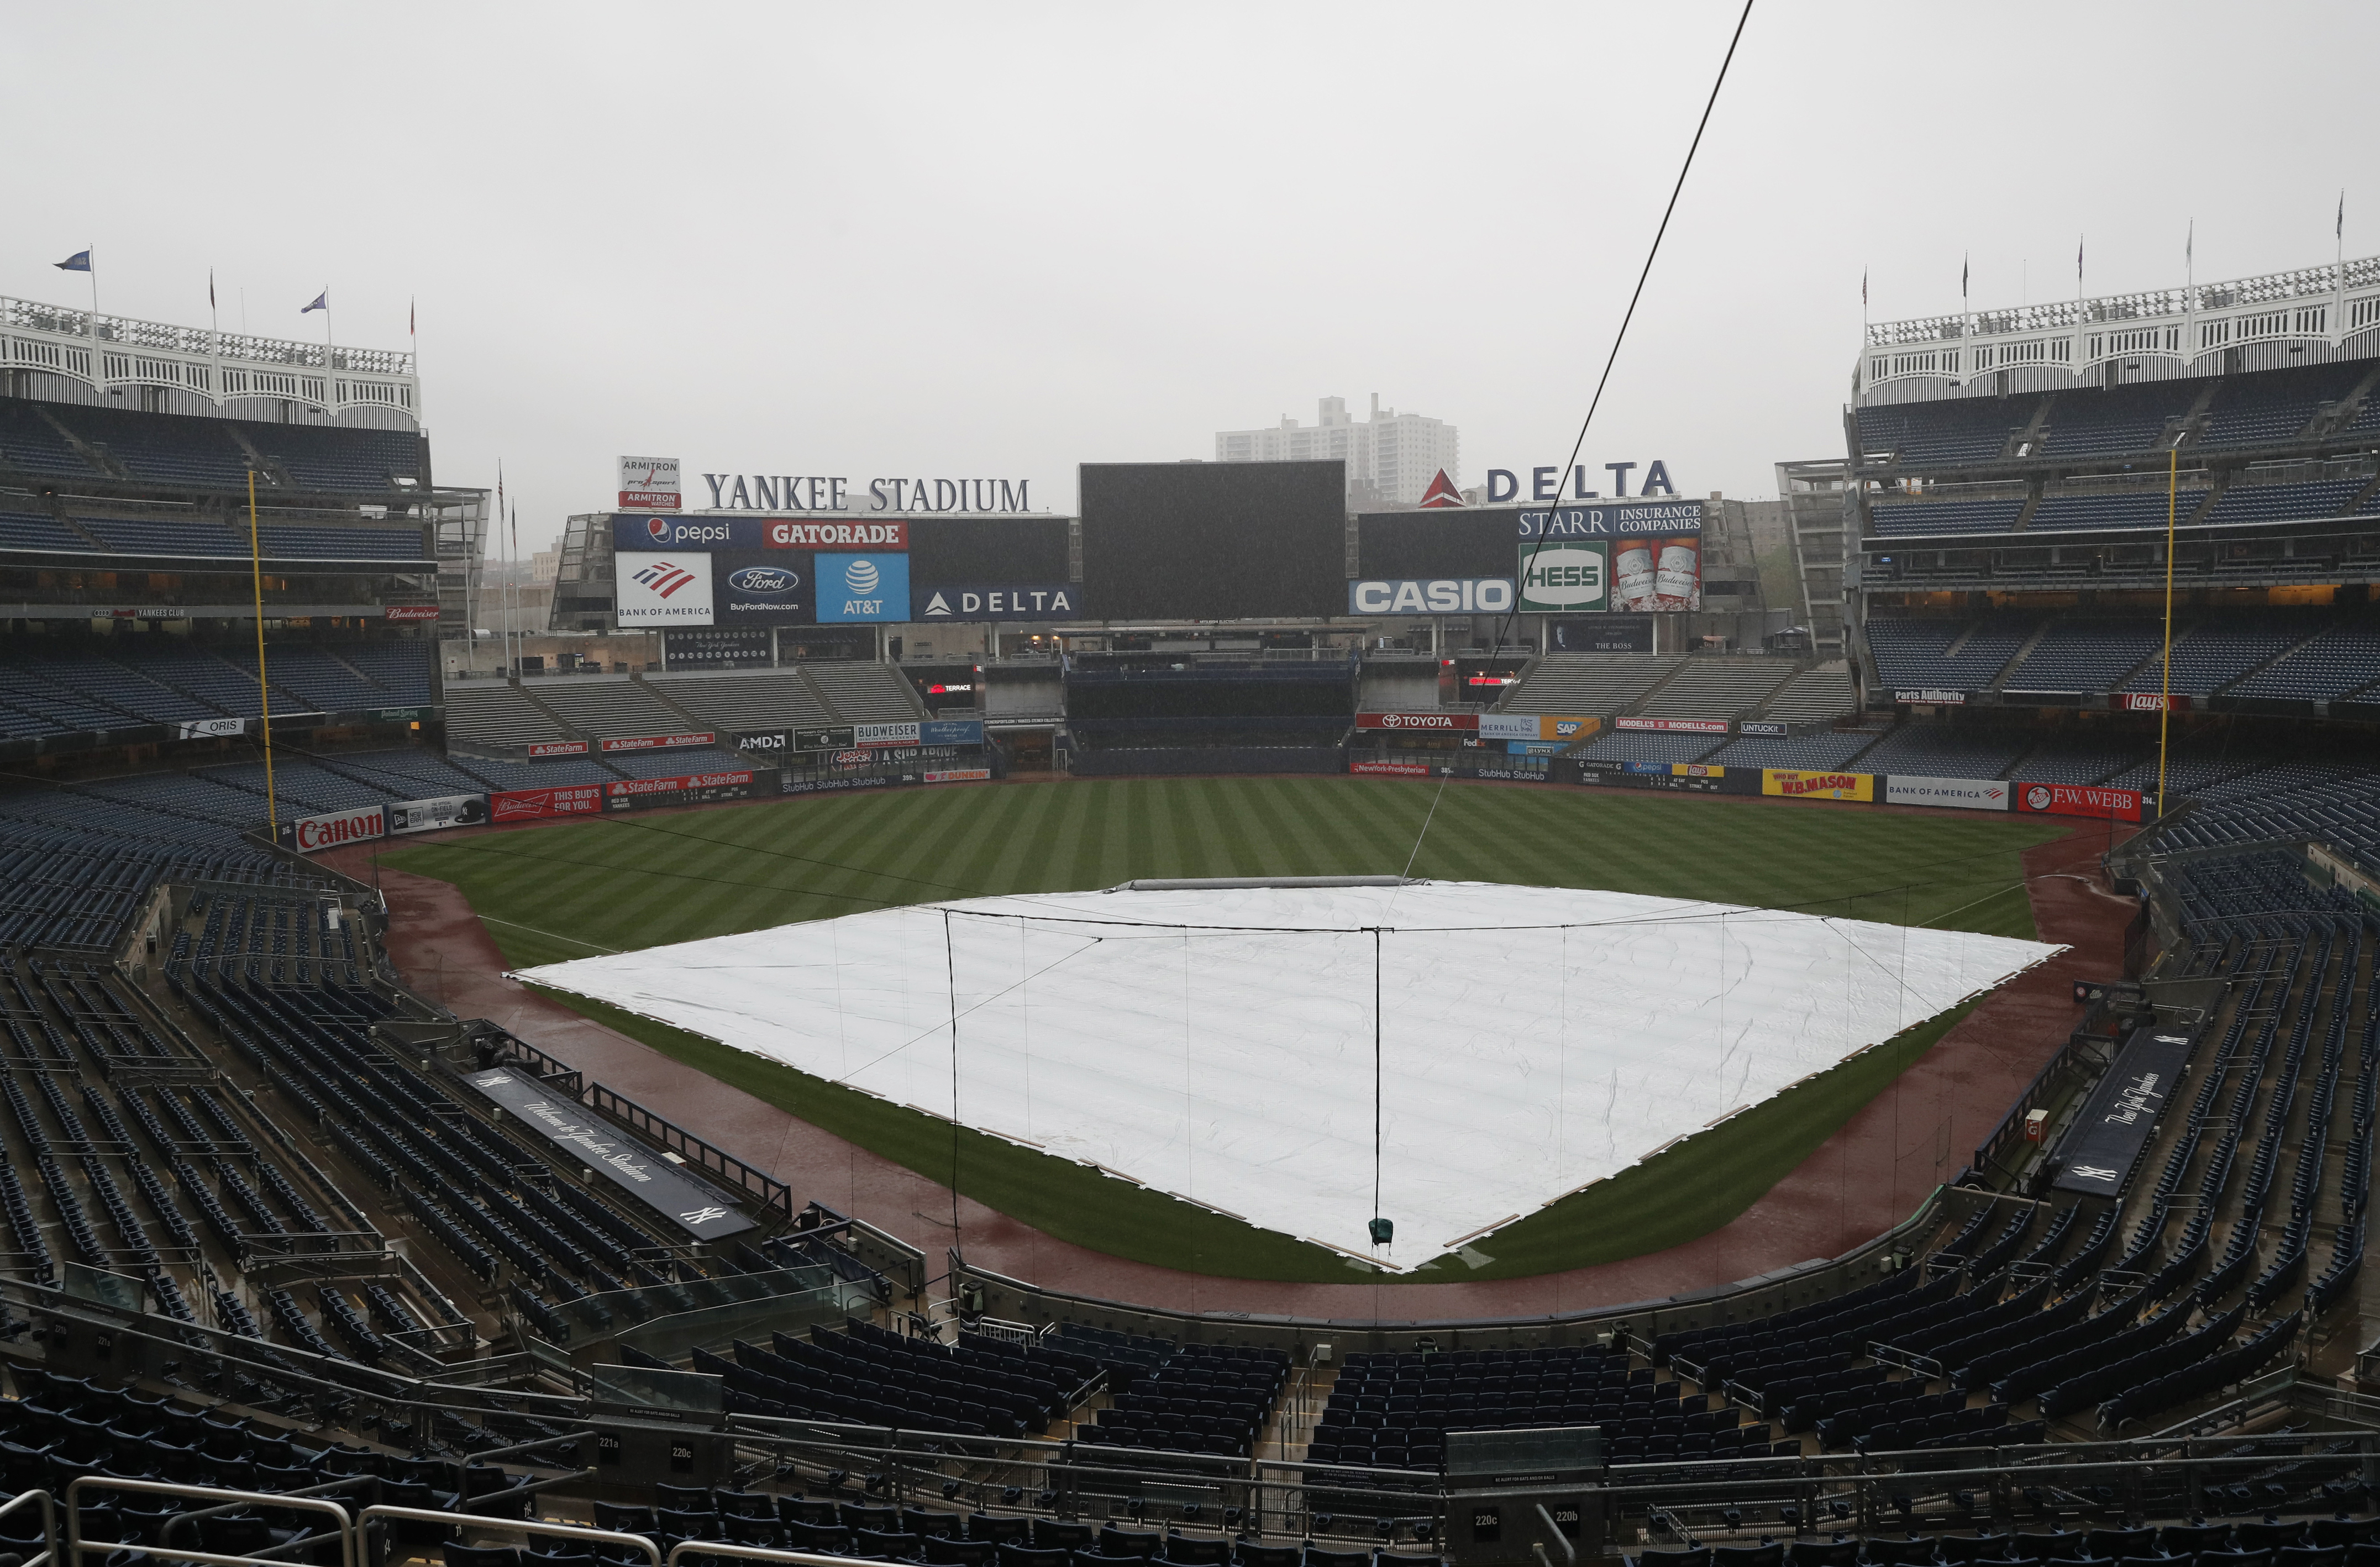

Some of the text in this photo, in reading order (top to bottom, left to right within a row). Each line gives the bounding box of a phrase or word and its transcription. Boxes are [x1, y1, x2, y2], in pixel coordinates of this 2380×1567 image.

[623, 461, 677, 471] ARMITRON
[1488, 460, 1678, 502] DELTA
[627, 493, 675, 502] ARMITRON
[701, 474, 1030, 512] YANKEE STADIUM
[1620, 506, 1700, 520] INSURANCE
[1519, 511, 1609, 535] STARR
[1620, 518, 1700, 532] COMPANIES
[676, 523, 730, 544] pepsi
[772, 524, 899, 544] GATORADE
[742, 571, 785, 588] Ford
[1528, 566, 1599, 587] HESS
[963, 591, 1071, 612] DELTA
[1356, 580, 1511, 612] CASIO
[731, 603, 798, 611] BuyFordNow.com
[843, 600, 882, 614] AT&T
[387, 608, 439, 618] Budweiser
[1921, 690, 1964, 701] Authority
[381, 709, 418, 718] Poland Spring
[210, 721, 237, 731] ORIS
[1402, 717, 1453, 726] TOYOTA
[1669, 722, 1724, 730] MODELLS.com
[859, 725, 917, 737] BUDWEISER
[1557, 724, 1577, 733] SAP
[739, 736, 773, 749] AMD
[948, 770, 988, 780] DUNKIN'
[1479, 769, 1511, 778] StubHub
[1514, 771, 1545, 780] StubHub
[783, 782, 814, 792] StubHub
[817, 779, 849, 789] StubHub
[852, 777, 885, 786] StubHub
[554, 789, 599, 801] THIS BUD'S
[1934, 789, 1980, 798] AMERICA
[2032, 793, 2047, 803] WEBB
[2053, 788, 2132, 809] F.W. WEBB
[2142, 796, 2152, 804] 314
[555, 801, 592, 812] FOR YOU.
[298, 813, 383, 849] Canon
[2105, 1072, 2163, 1125] New York Yankees
[524, 1101, 567, 1127] Welcome
[554, 1129, 616, 1154] Yankee
[602, 1154, 652, 1181] Stadium
[600, 1438, 618, 1448] 221a
[673, 1448, 691, 1458] 220c
[1476, 1515, 1497, 1526] 220c
[1557, 1511, 1578, 1522] 220b
